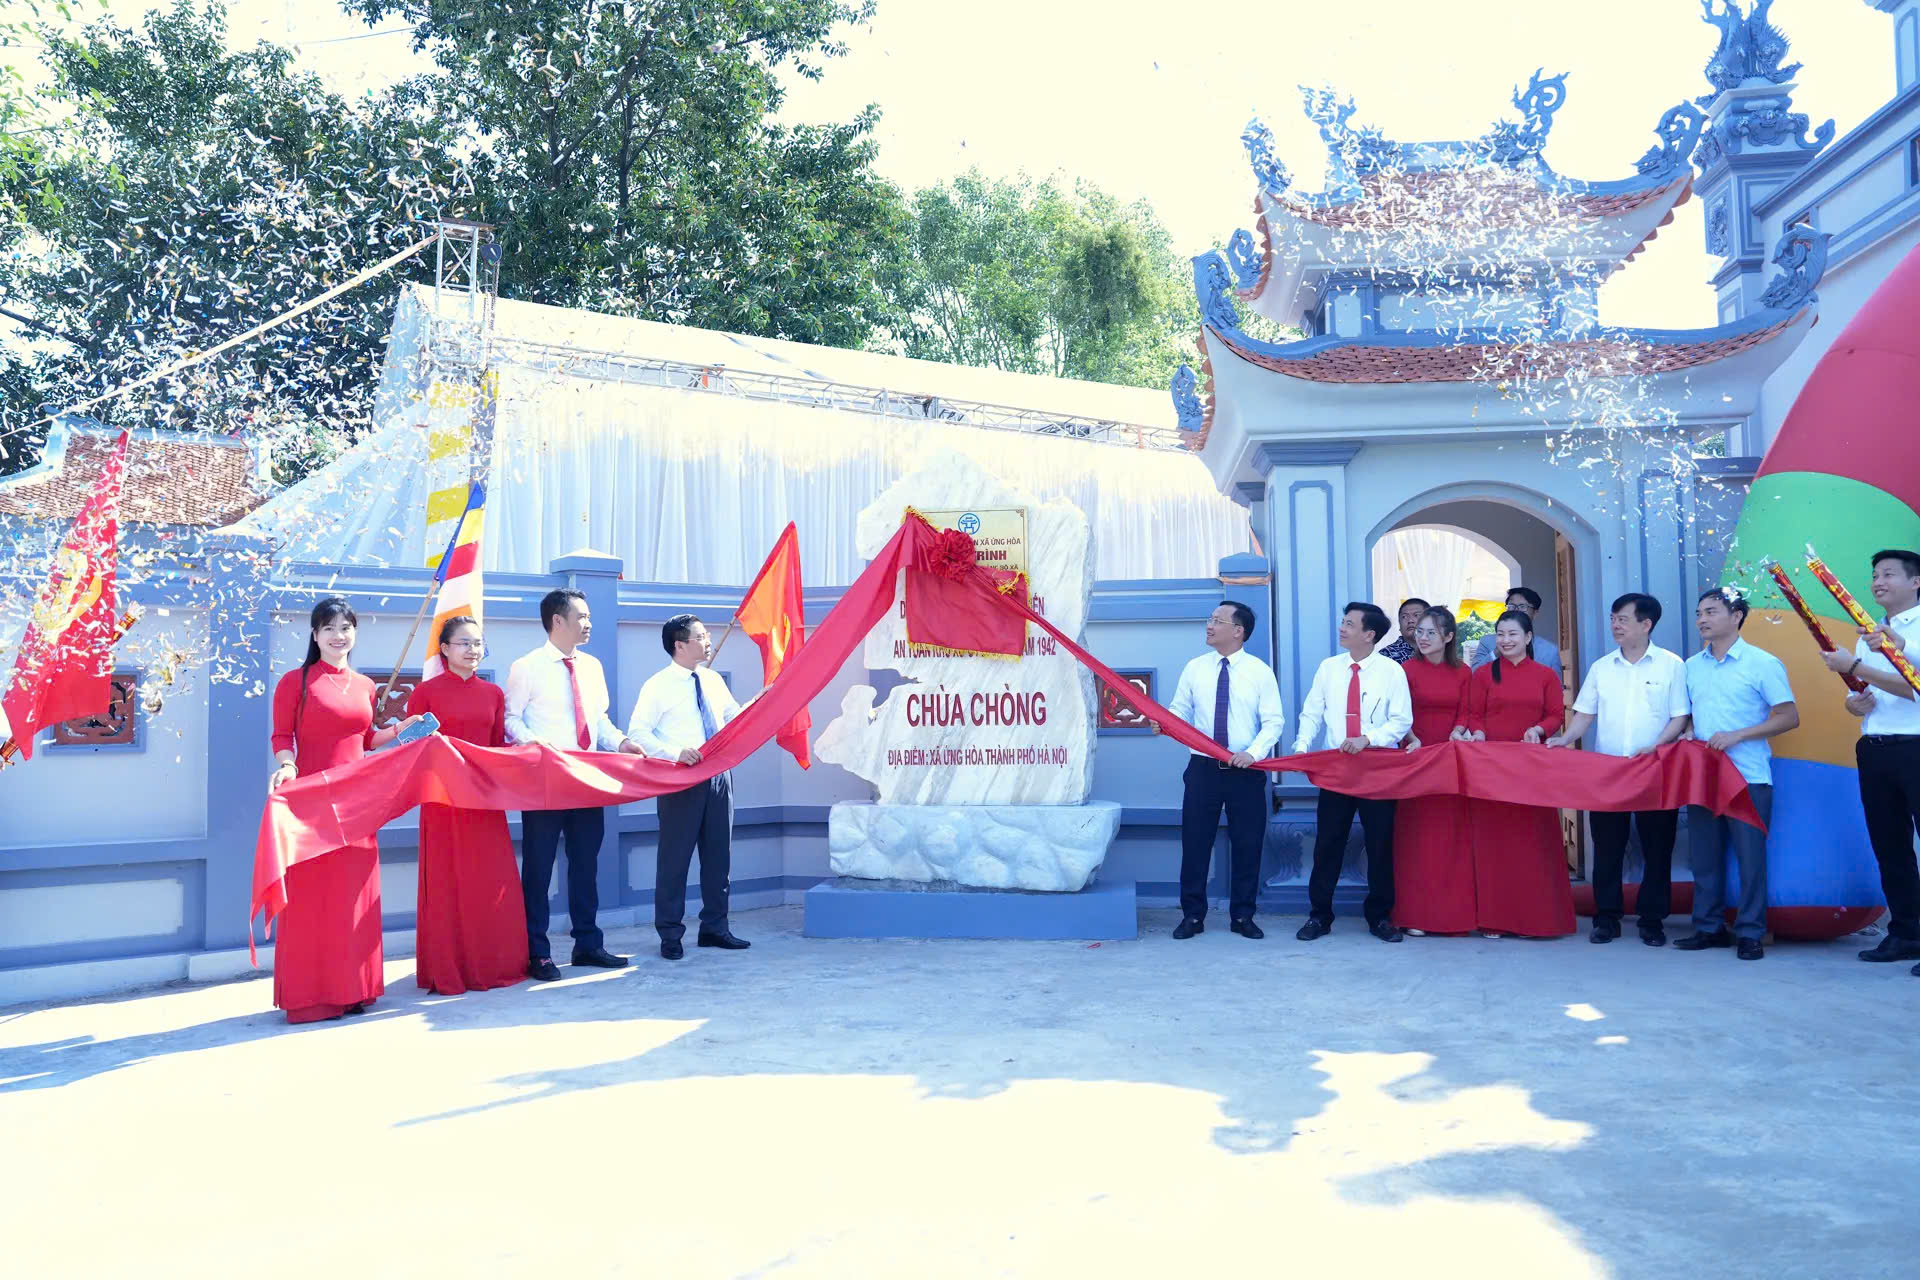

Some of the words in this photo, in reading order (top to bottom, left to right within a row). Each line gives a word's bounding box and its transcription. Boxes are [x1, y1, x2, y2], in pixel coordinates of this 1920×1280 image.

[980, 537, 990, 546] XÃ
[974, 548, 1007, 561] RÌNH
[893, 639, 906, 658] AN
[1037, 636, 1057, 656] 1942
[906, 684, 966, 727] CHÙA
[970, 683, 1047, 726] CHÒNG
[888, 749, 903, 770] ĐỊA
[929, 745, 942, 766] XÃ
[943, 745, 963, 766] ỨNG
[965, 744, 984, 766] HÒA
[985, 744, 1015, 766] THÀNH
[1016, 744, 1036, 765] PHỐ
[1037, 743, 1051, 765] HÀ
[1052, 745, 1068, 769] NỘI
